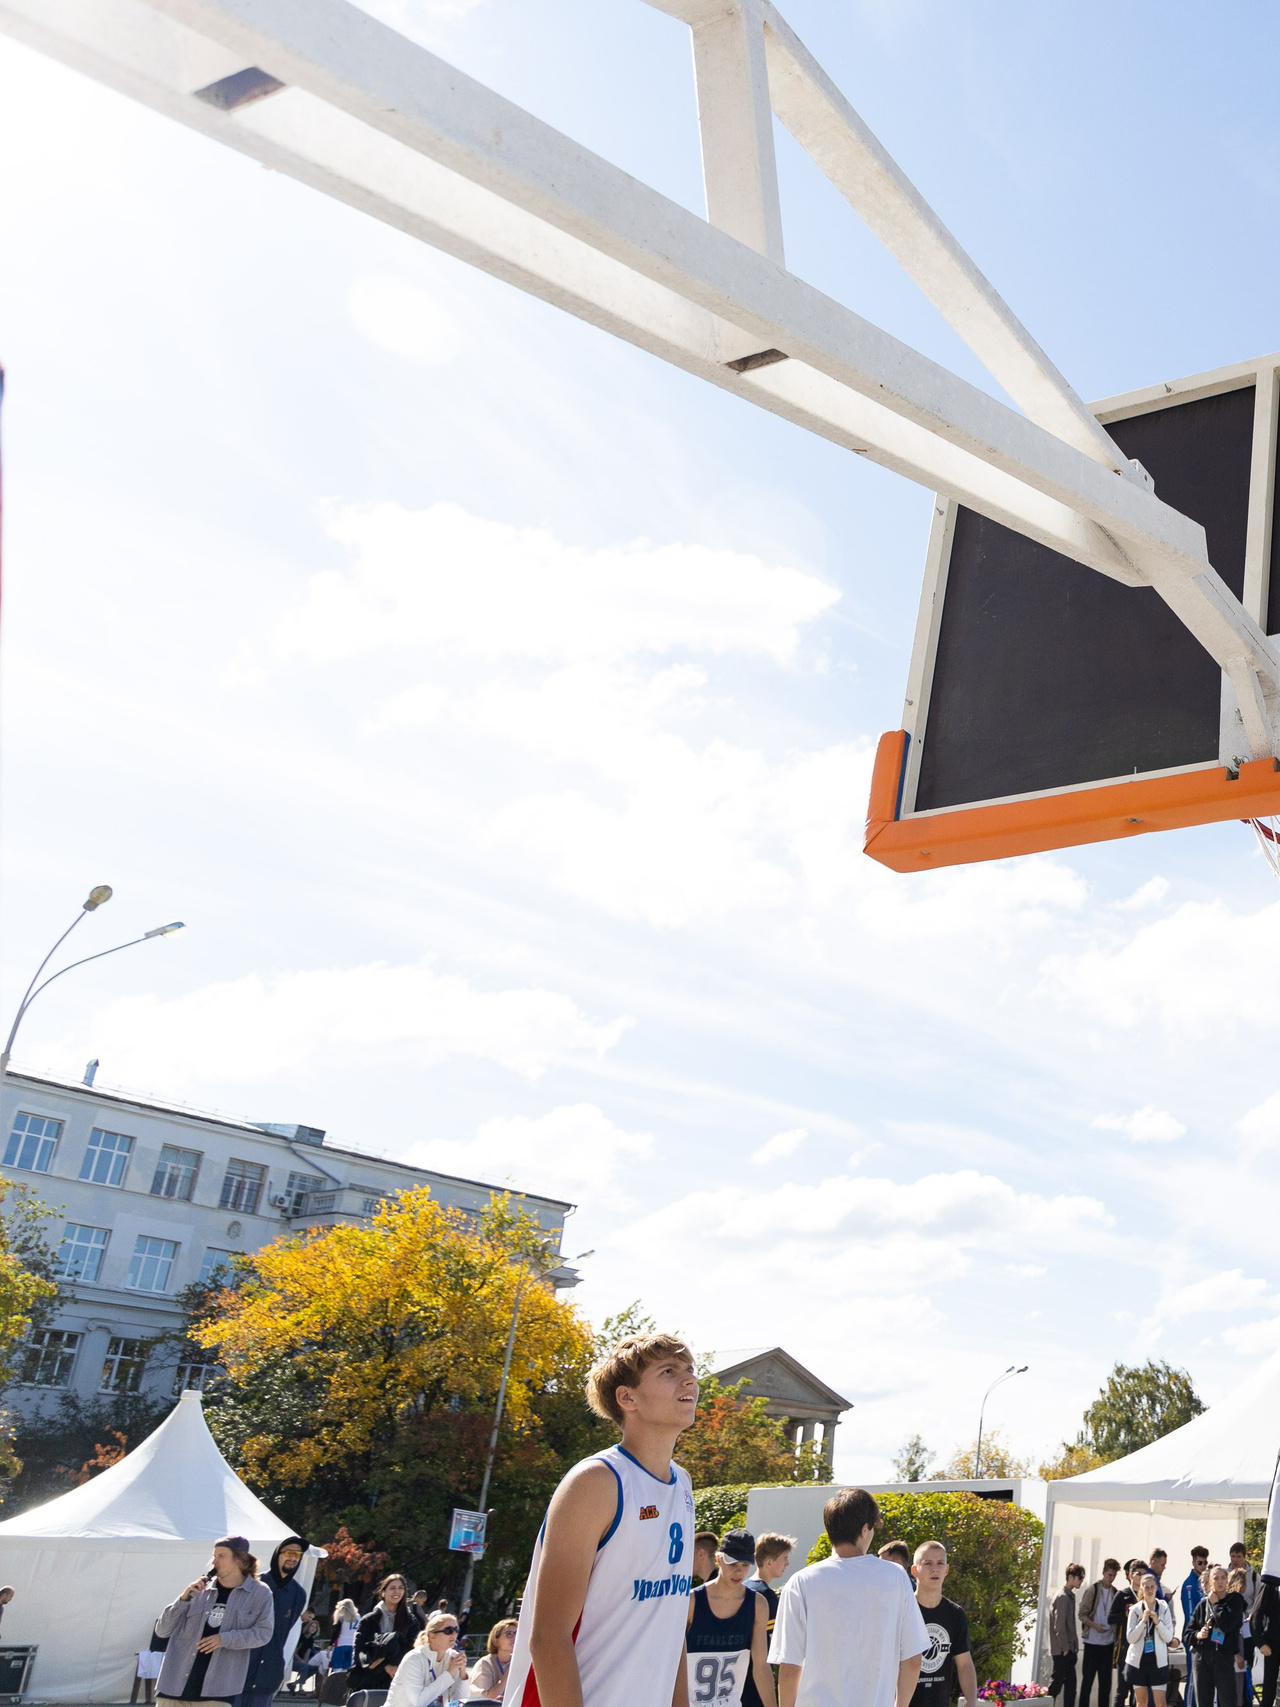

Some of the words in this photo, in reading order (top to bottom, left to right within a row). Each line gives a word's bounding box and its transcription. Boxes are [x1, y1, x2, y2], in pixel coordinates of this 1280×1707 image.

[668, 1522, 684, 1565] 8
[696, 1634, 745, 1646] FEARLESS
[694, 1653, 741, 1703] 95
